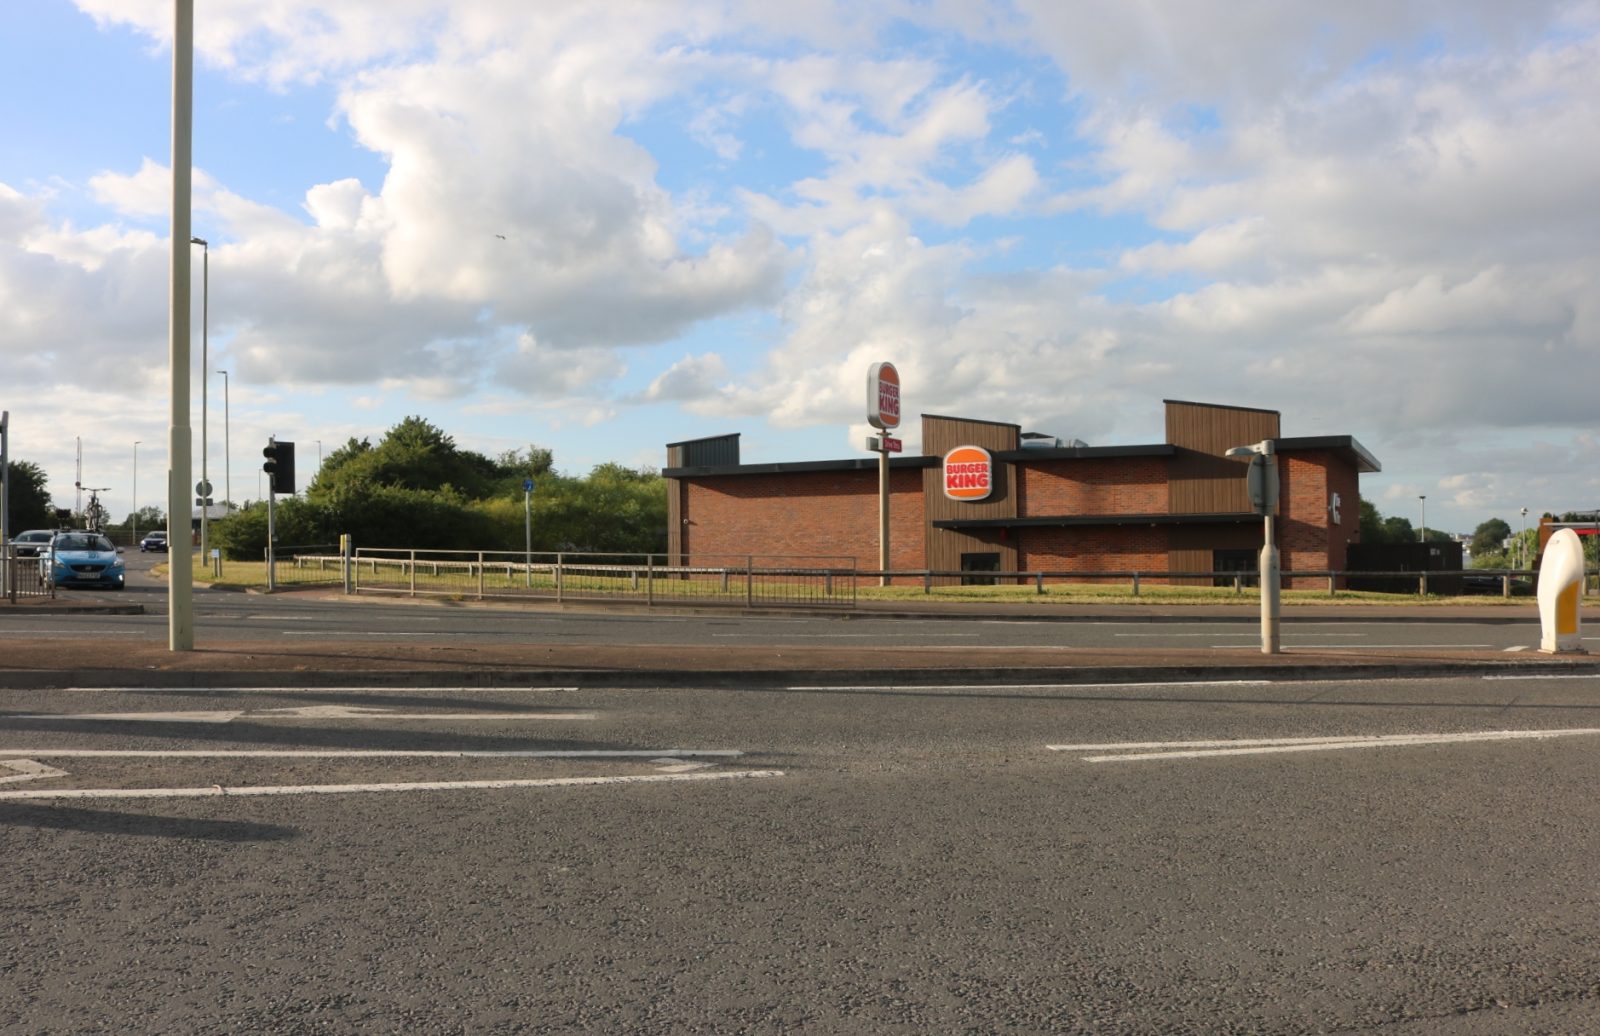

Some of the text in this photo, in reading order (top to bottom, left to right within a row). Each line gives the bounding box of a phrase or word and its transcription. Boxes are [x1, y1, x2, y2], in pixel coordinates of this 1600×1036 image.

[879, 382, 899, 399] BURGER
[879, 395, 899, 415] KING
[946, 464, 988, 474] BURGER
[946, 474, 988, 488] KING
